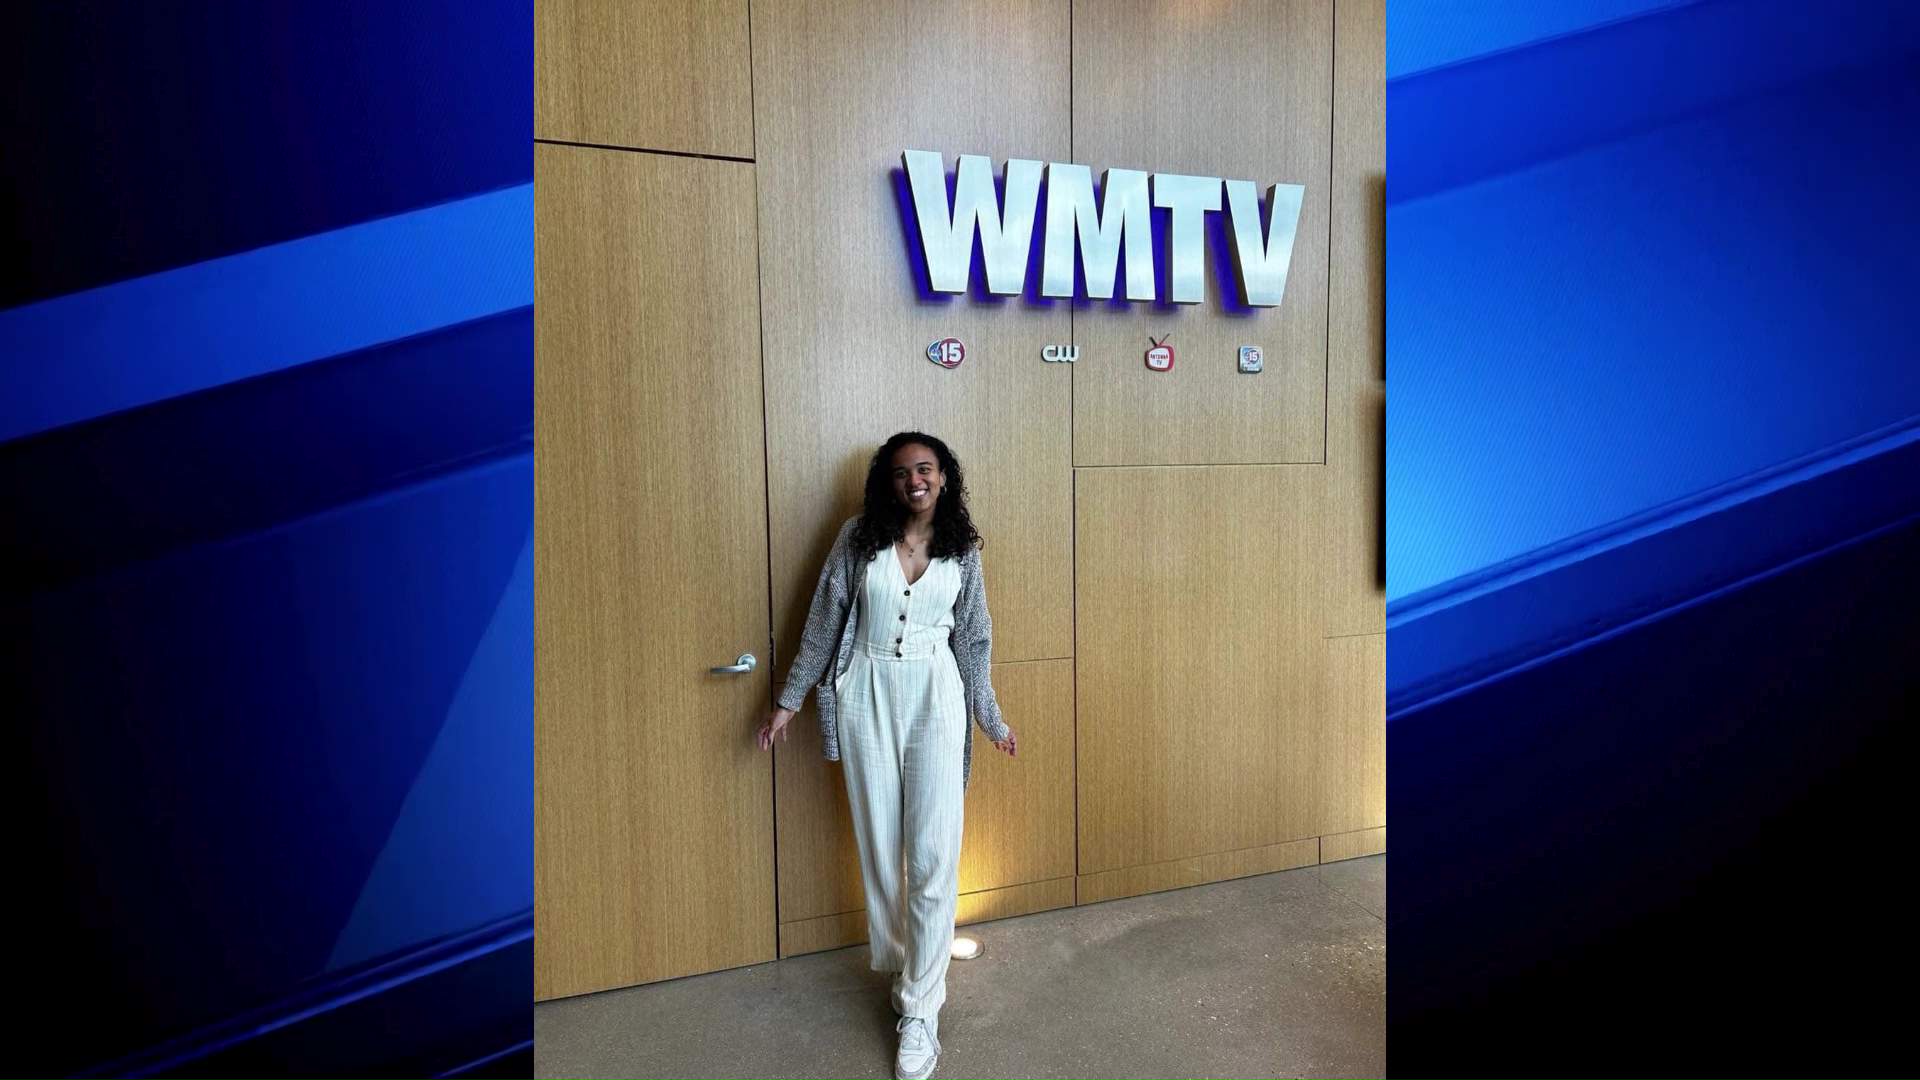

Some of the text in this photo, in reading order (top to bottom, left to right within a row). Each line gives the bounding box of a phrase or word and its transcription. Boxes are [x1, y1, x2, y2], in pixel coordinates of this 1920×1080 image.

[902, 149, 1305, 307] WMTV
[941, 342, 961, 362] 15
[1042, 345, 1079, 362] CW
[1249, 352, 1258, 361] 15
